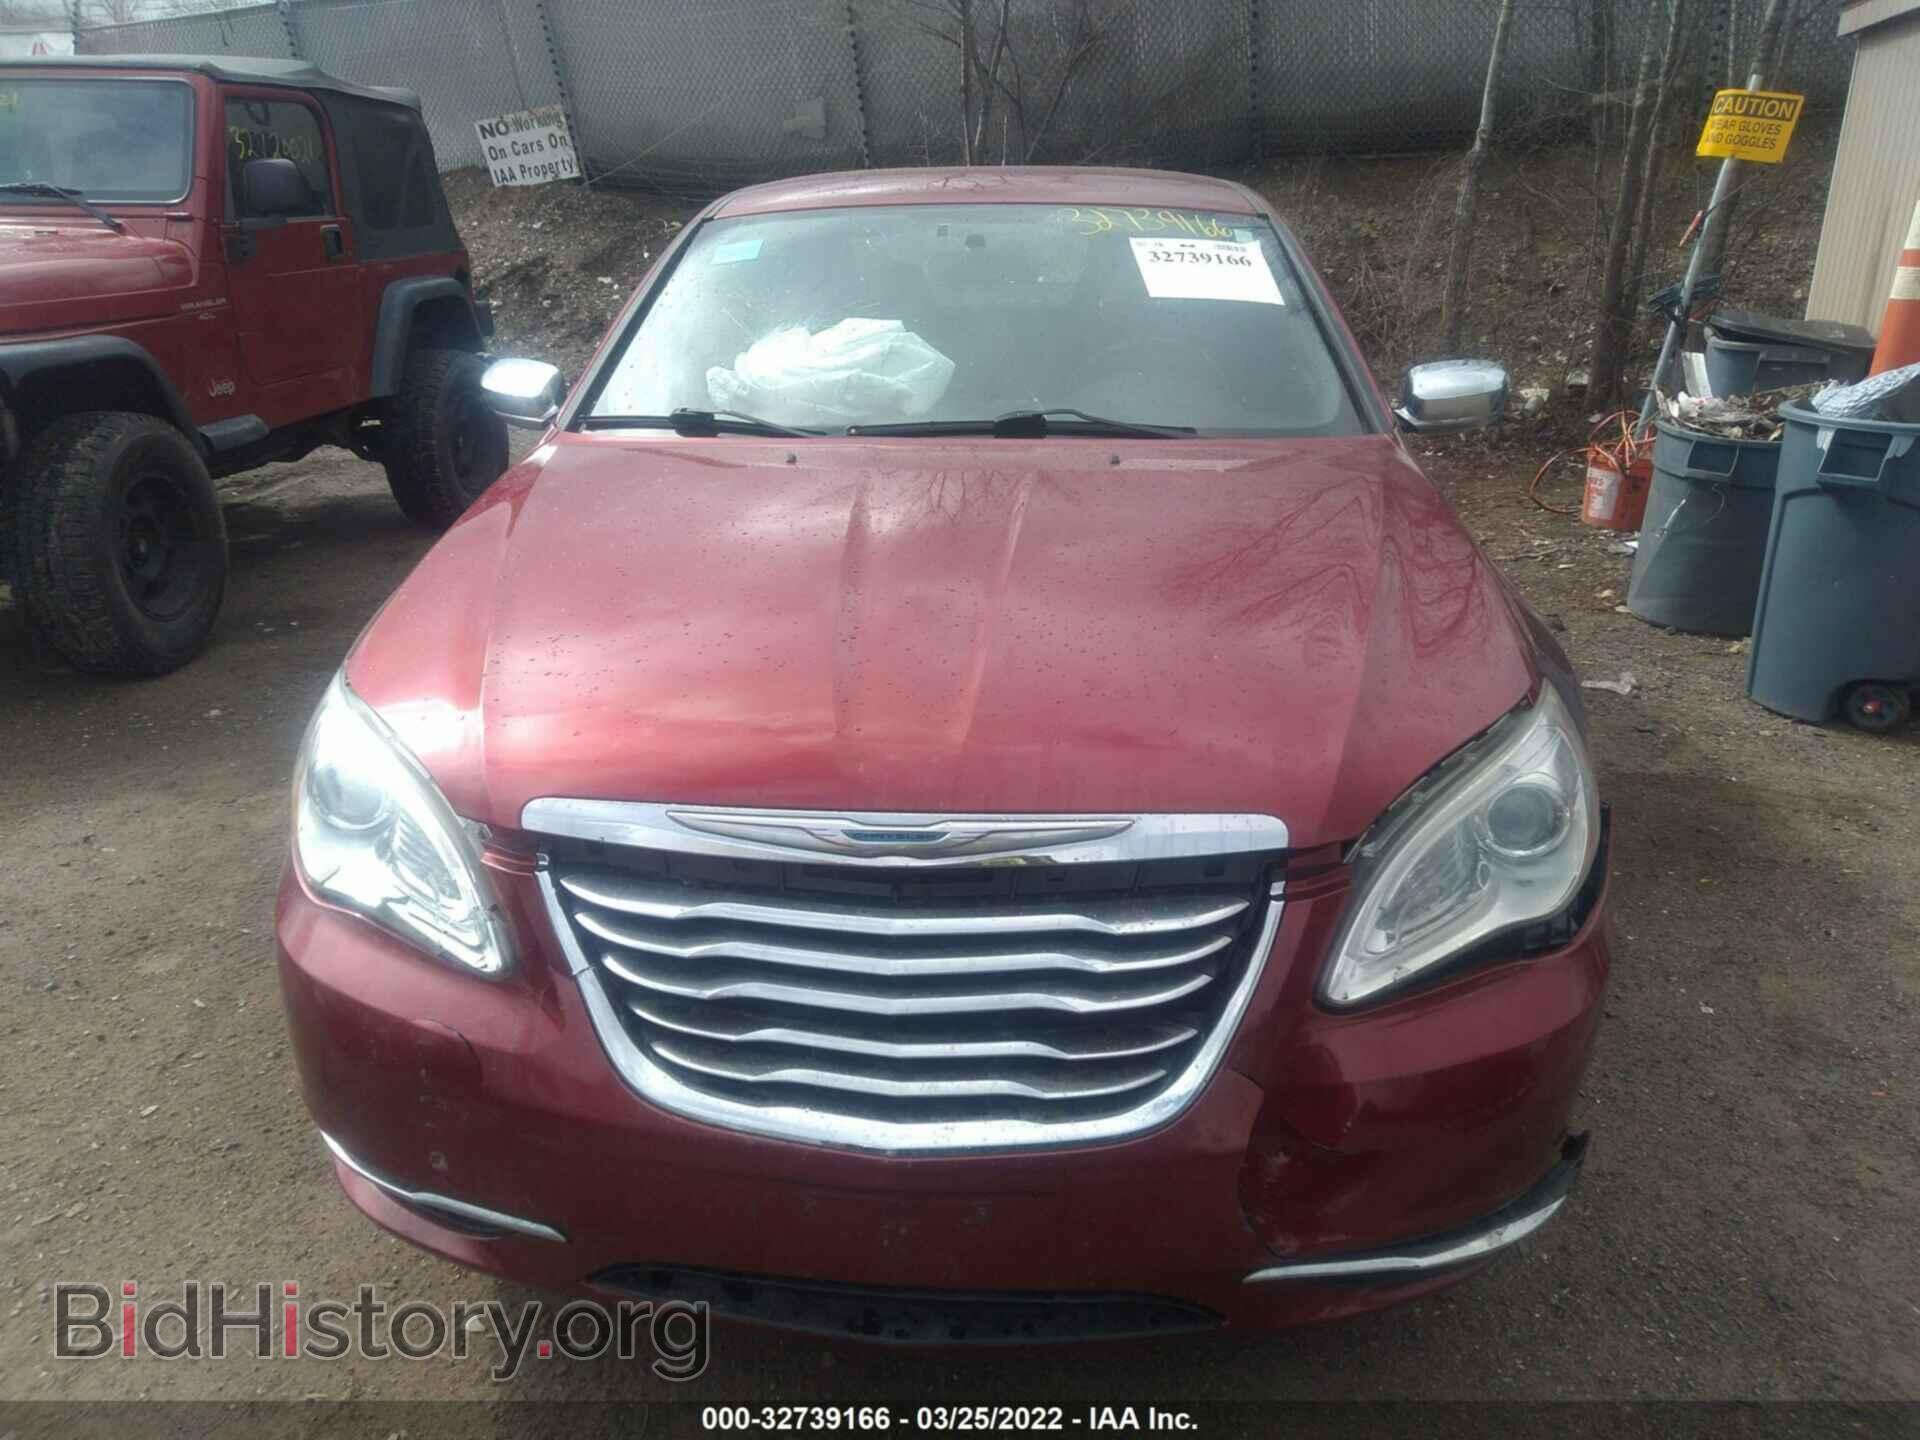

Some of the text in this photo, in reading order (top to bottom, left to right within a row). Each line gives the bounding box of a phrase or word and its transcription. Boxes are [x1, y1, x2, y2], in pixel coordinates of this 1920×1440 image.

[1713, 96, 1795, 119] CAUTION
[479, 120, 509, 140] NO
[1738, 120, 1782, 135] GLOVES
[488, 133, 568, 161] On Cars On
[1725, 133, 1777, 150] GOGGLES
[494, 156, 574, 185] IAA Property
[1148, 250, 1253, 268] 32739166
[209, 377, 236, 398] Jeep
